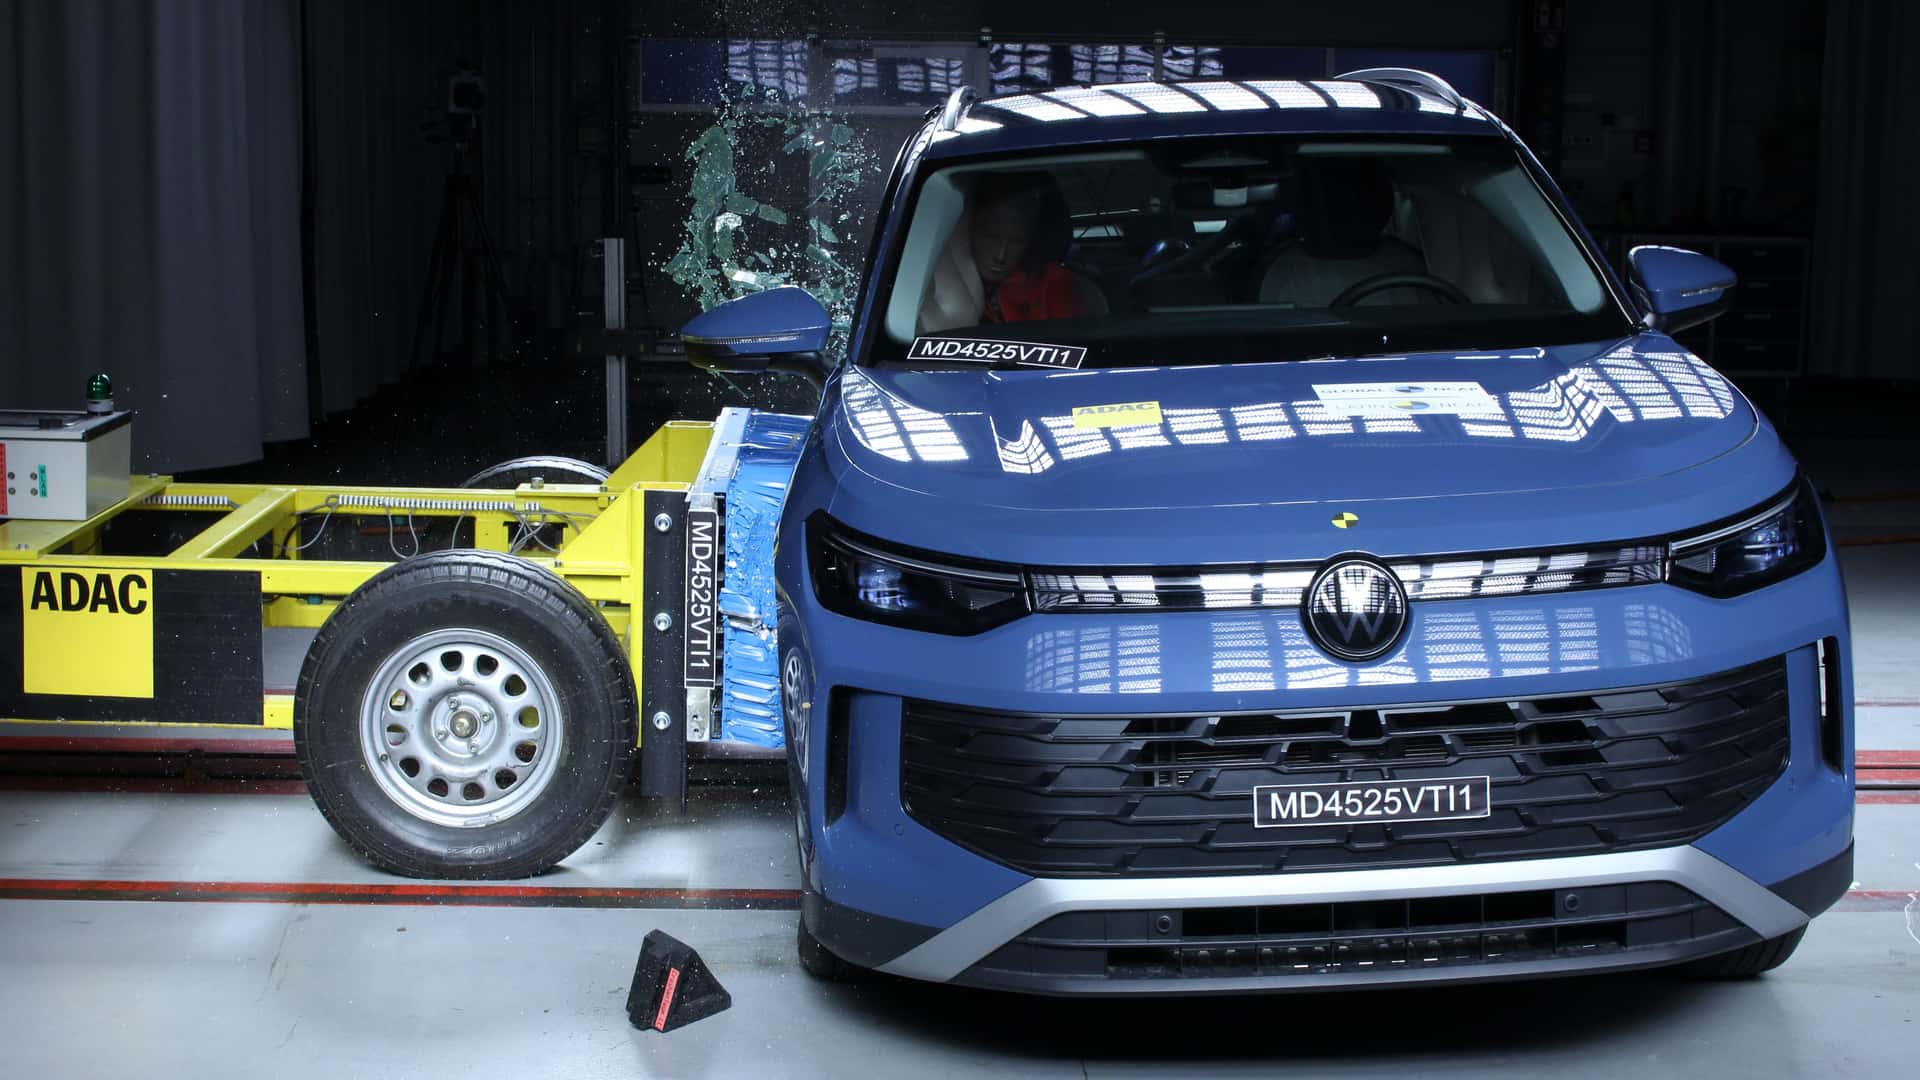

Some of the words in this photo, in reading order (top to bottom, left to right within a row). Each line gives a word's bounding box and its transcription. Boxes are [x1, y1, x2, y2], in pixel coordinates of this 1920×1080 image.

[921, 340, 1071, 365] MD4525VTI1
[1077, 403, 1156, 415] ADAC
[30, 571, 148, 615] ADAC
[690, 521, 712, 667] MD4525VTI1
[1270, 784, 1472, 820] MD4525VTI1
